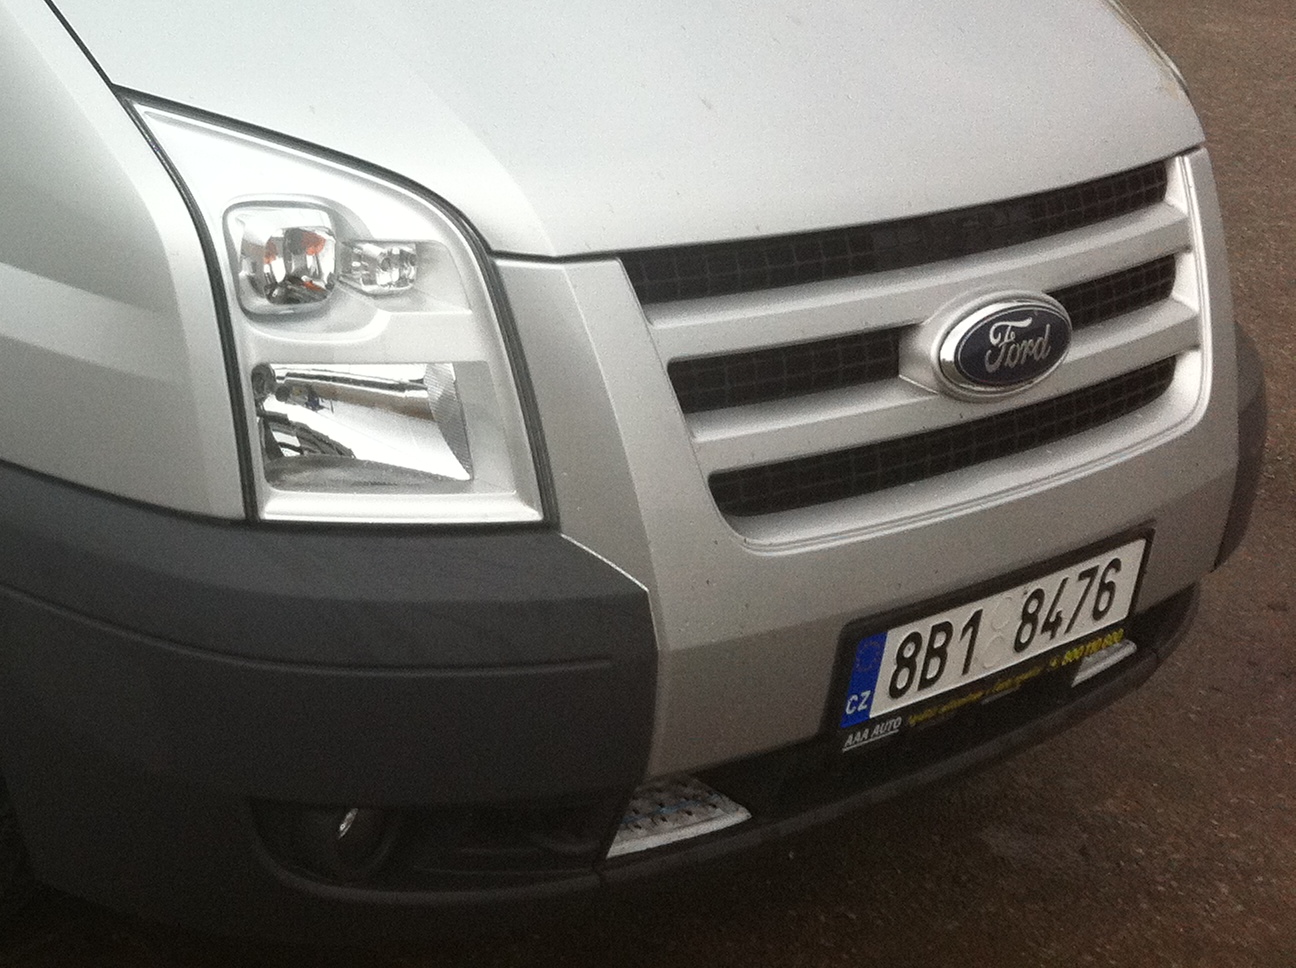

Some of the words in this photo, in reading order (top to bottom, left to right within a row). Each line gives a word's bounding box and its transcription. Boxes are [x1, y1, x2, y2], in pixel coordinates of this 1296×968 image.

[984, 317, 1051, 373] Ford
[888, 608, 983, 699] 8B1
[1014, 557, 1122, 653] 8476
[845, 690, 871, 715] CZ
[845, 728, 869, 747] AAA
[871, 717, 902, 738] AUTO
